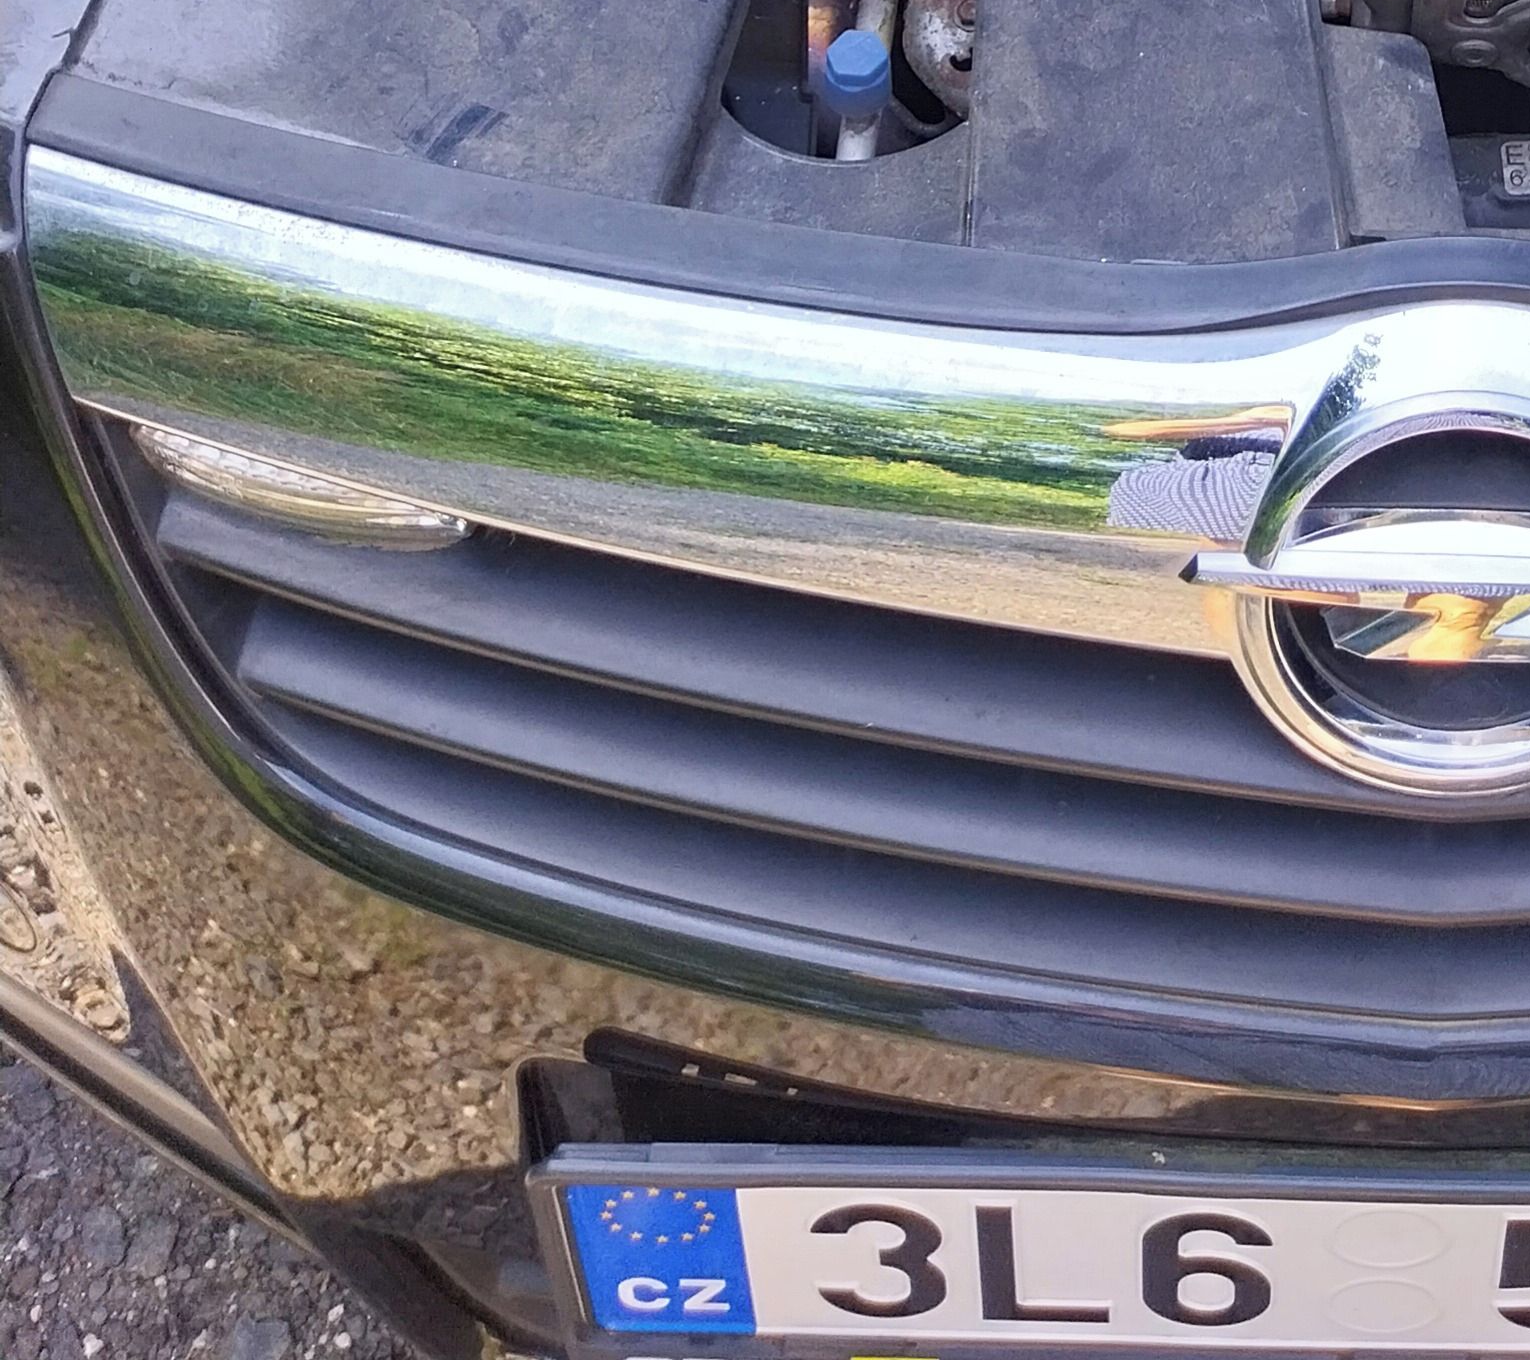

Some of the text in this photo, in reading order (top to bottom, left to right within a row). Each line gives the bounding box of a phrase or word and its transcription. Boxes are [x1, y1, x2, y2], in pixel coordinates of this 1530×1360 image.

[1505, 144, 1525, 166] E
[1510, 169, 1524, 187] 6
[808, 1202, 1275, 1327] 3L6
[617, 1276, 731, 1313] CZ
